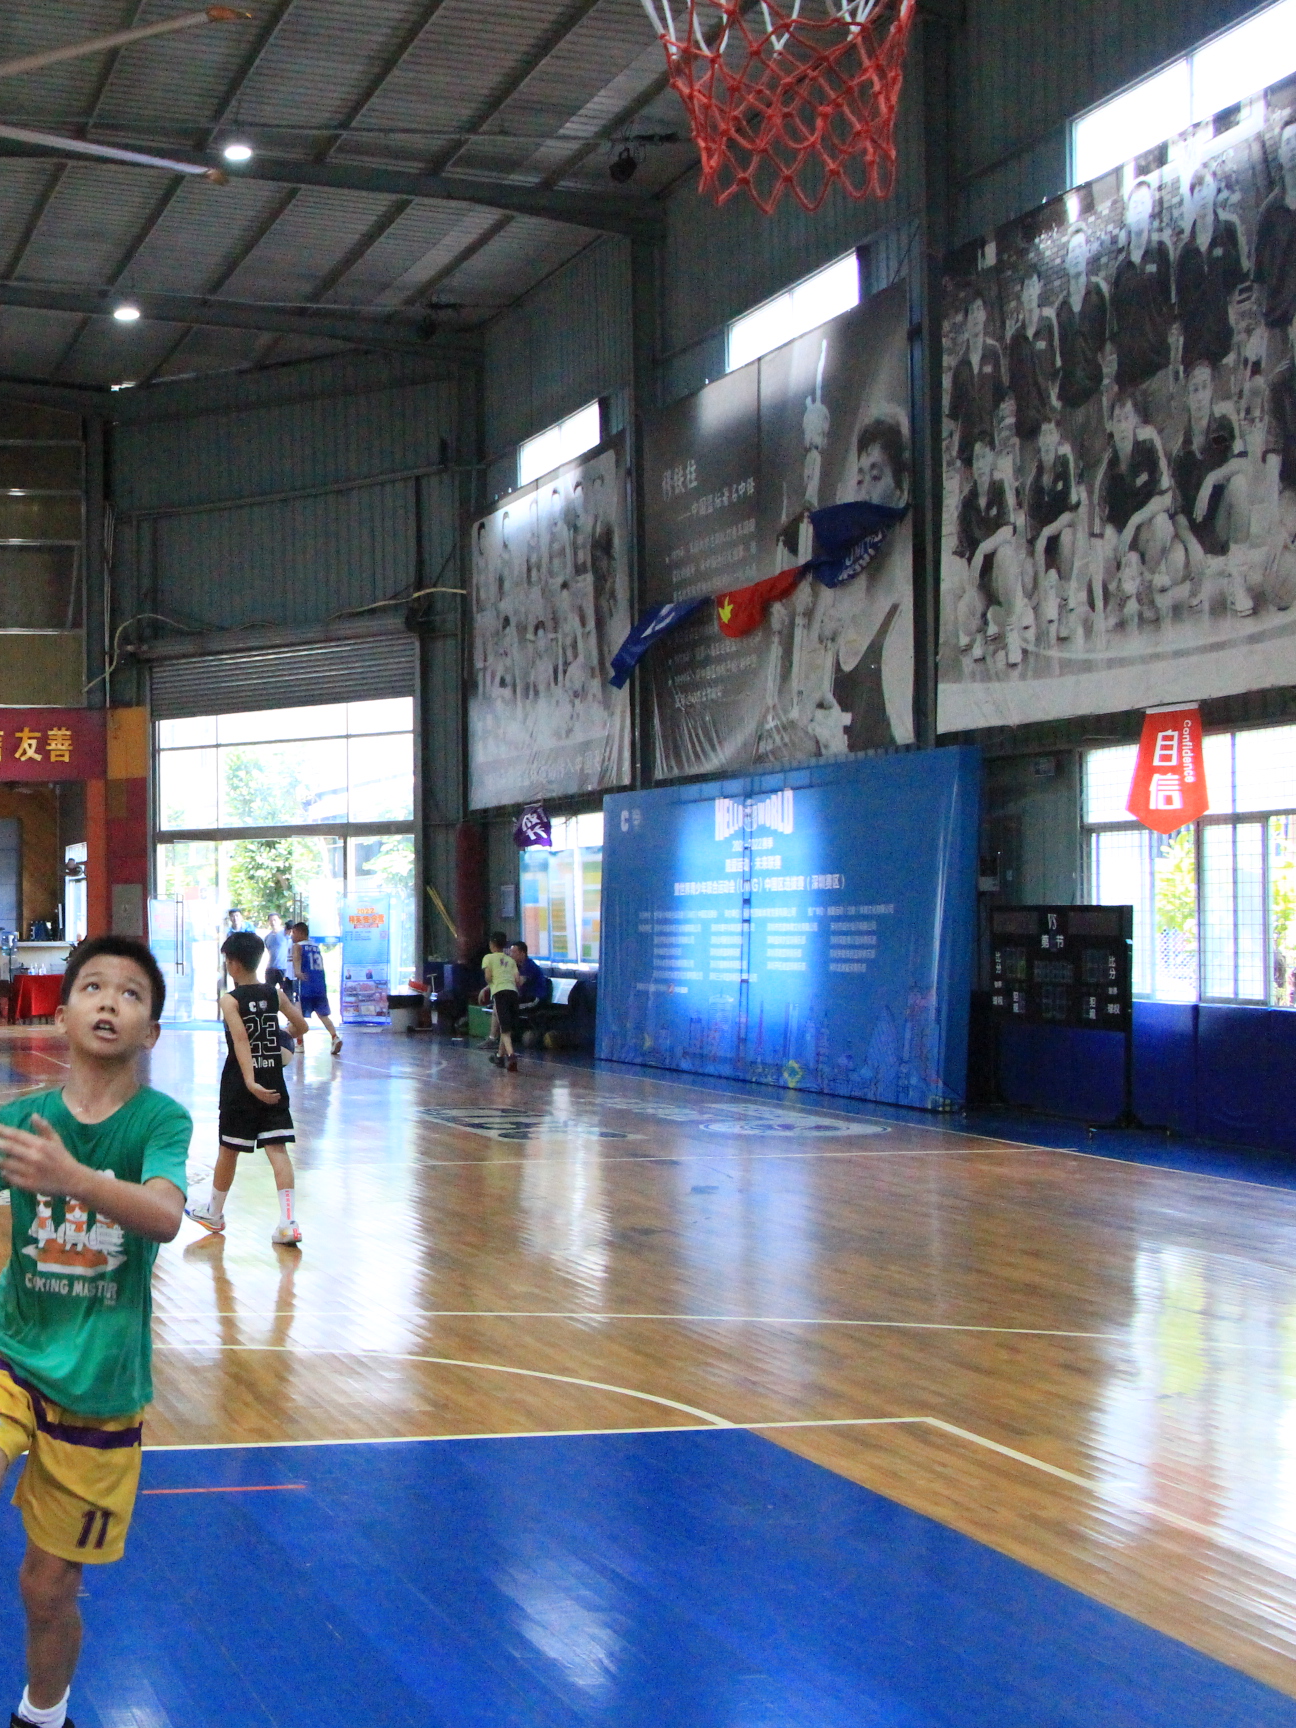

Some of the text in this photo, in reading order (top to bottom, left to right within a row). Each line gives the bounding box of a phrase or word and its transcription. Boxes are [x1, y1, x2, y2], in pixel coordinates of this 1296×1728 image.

[15, 727, 74, 763] 友善
[1149, 729, 1183, 810] 自信
[757, 788, 794, 834] WORLD
[1048, 913, 1057, 930] VS
[308, 952, 323, 970] 13
[242, 1013, 282, 1056] 23
[251, 1057, 275, 1069] Allen
[76, 1509, 116, 1550] 11
